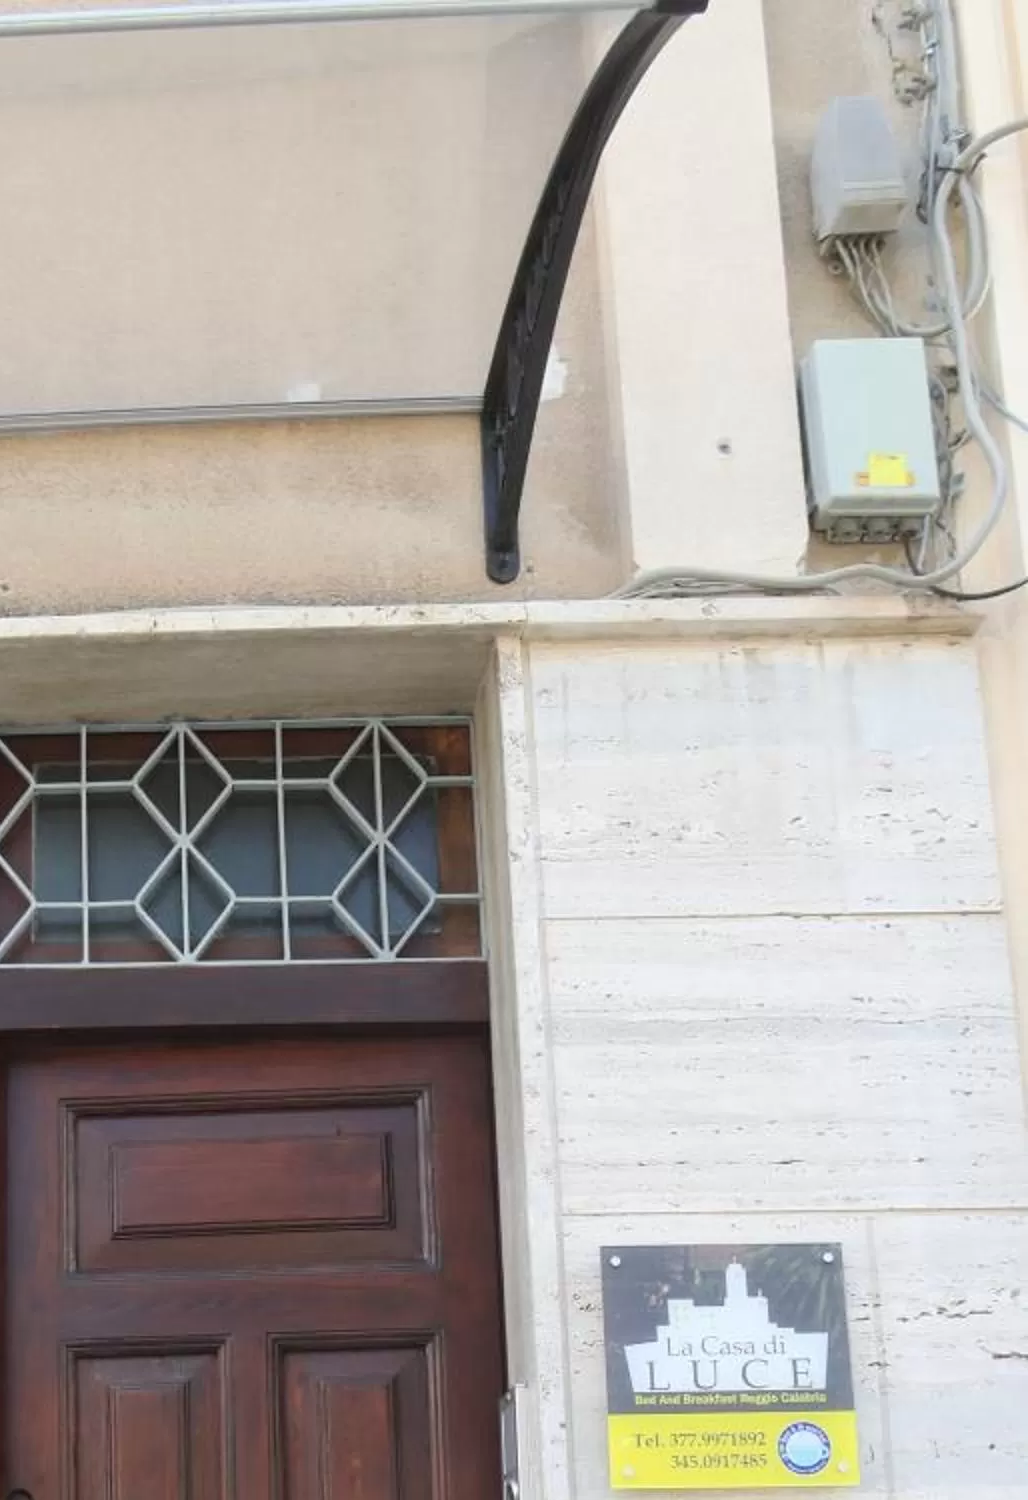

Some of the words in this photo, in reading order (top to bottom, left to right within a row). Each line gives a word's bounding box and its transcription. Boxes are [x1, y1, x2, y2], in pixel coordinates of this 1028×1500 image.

[666, 1335, 693, 1357] La
[700, 1335, 756, 1357] Casa
[763, 1334, 786, 1355] di
[646, 1357, 813, 1392] LUCE
[634, 1394, 657, 1406] Bed
[659, 1394, 681, 1405] And
[682, 1393, 738, 1405] Breakfast
[739, 1391, 778, 1406] Reggio
[780, 1391, 828, 1404] Calabria
[635, 1432, 664, 1448] Tel.
